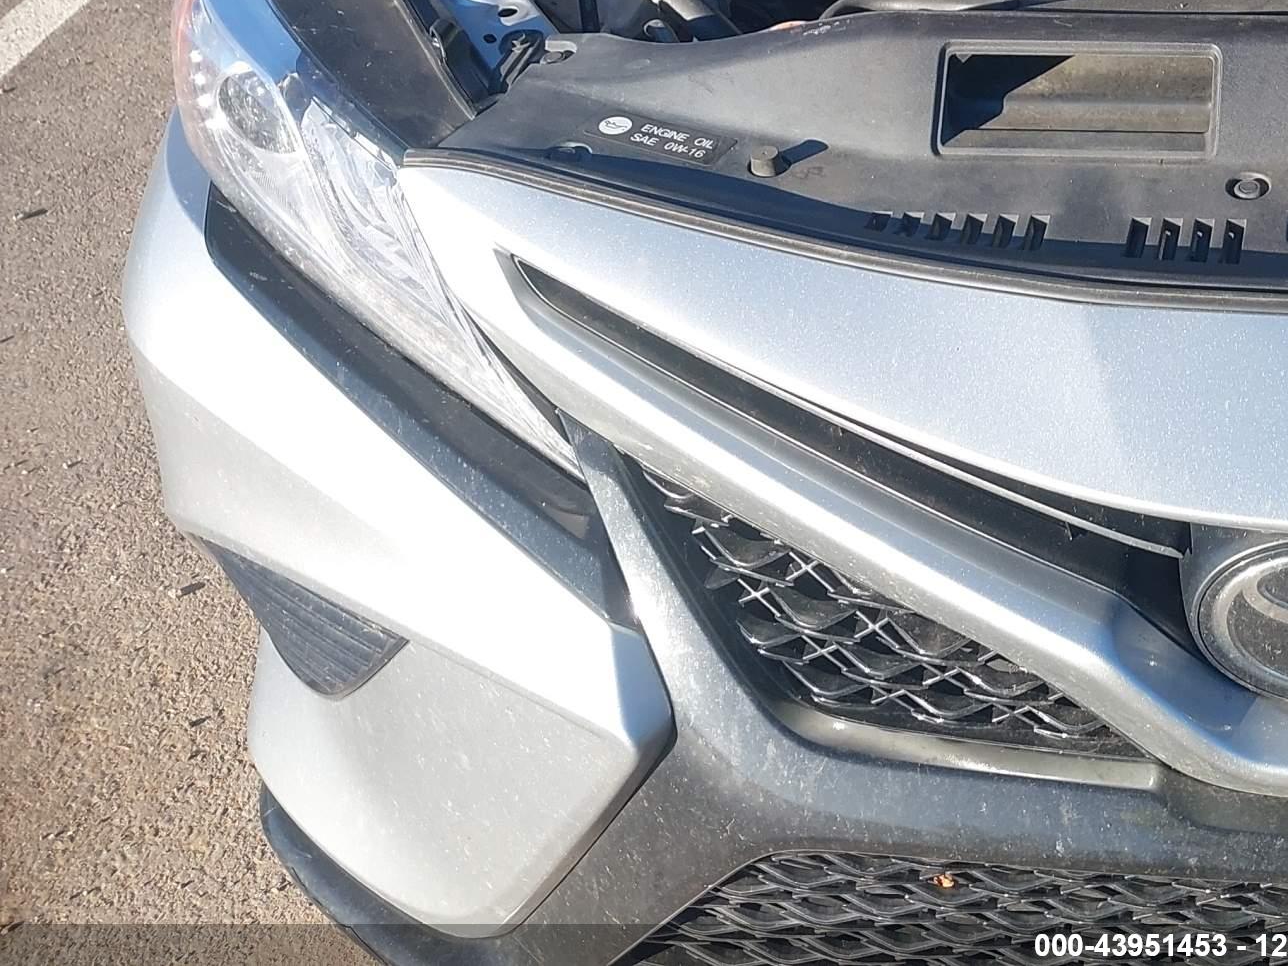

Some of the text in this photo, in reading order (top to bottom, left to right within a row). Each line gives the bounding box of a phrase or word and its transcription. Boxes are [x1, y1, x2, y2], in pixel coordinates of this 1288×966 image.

[630, 133, 706, 158] SAE 0W-16
[641, 124, 714, 149] ENGINE OIL
